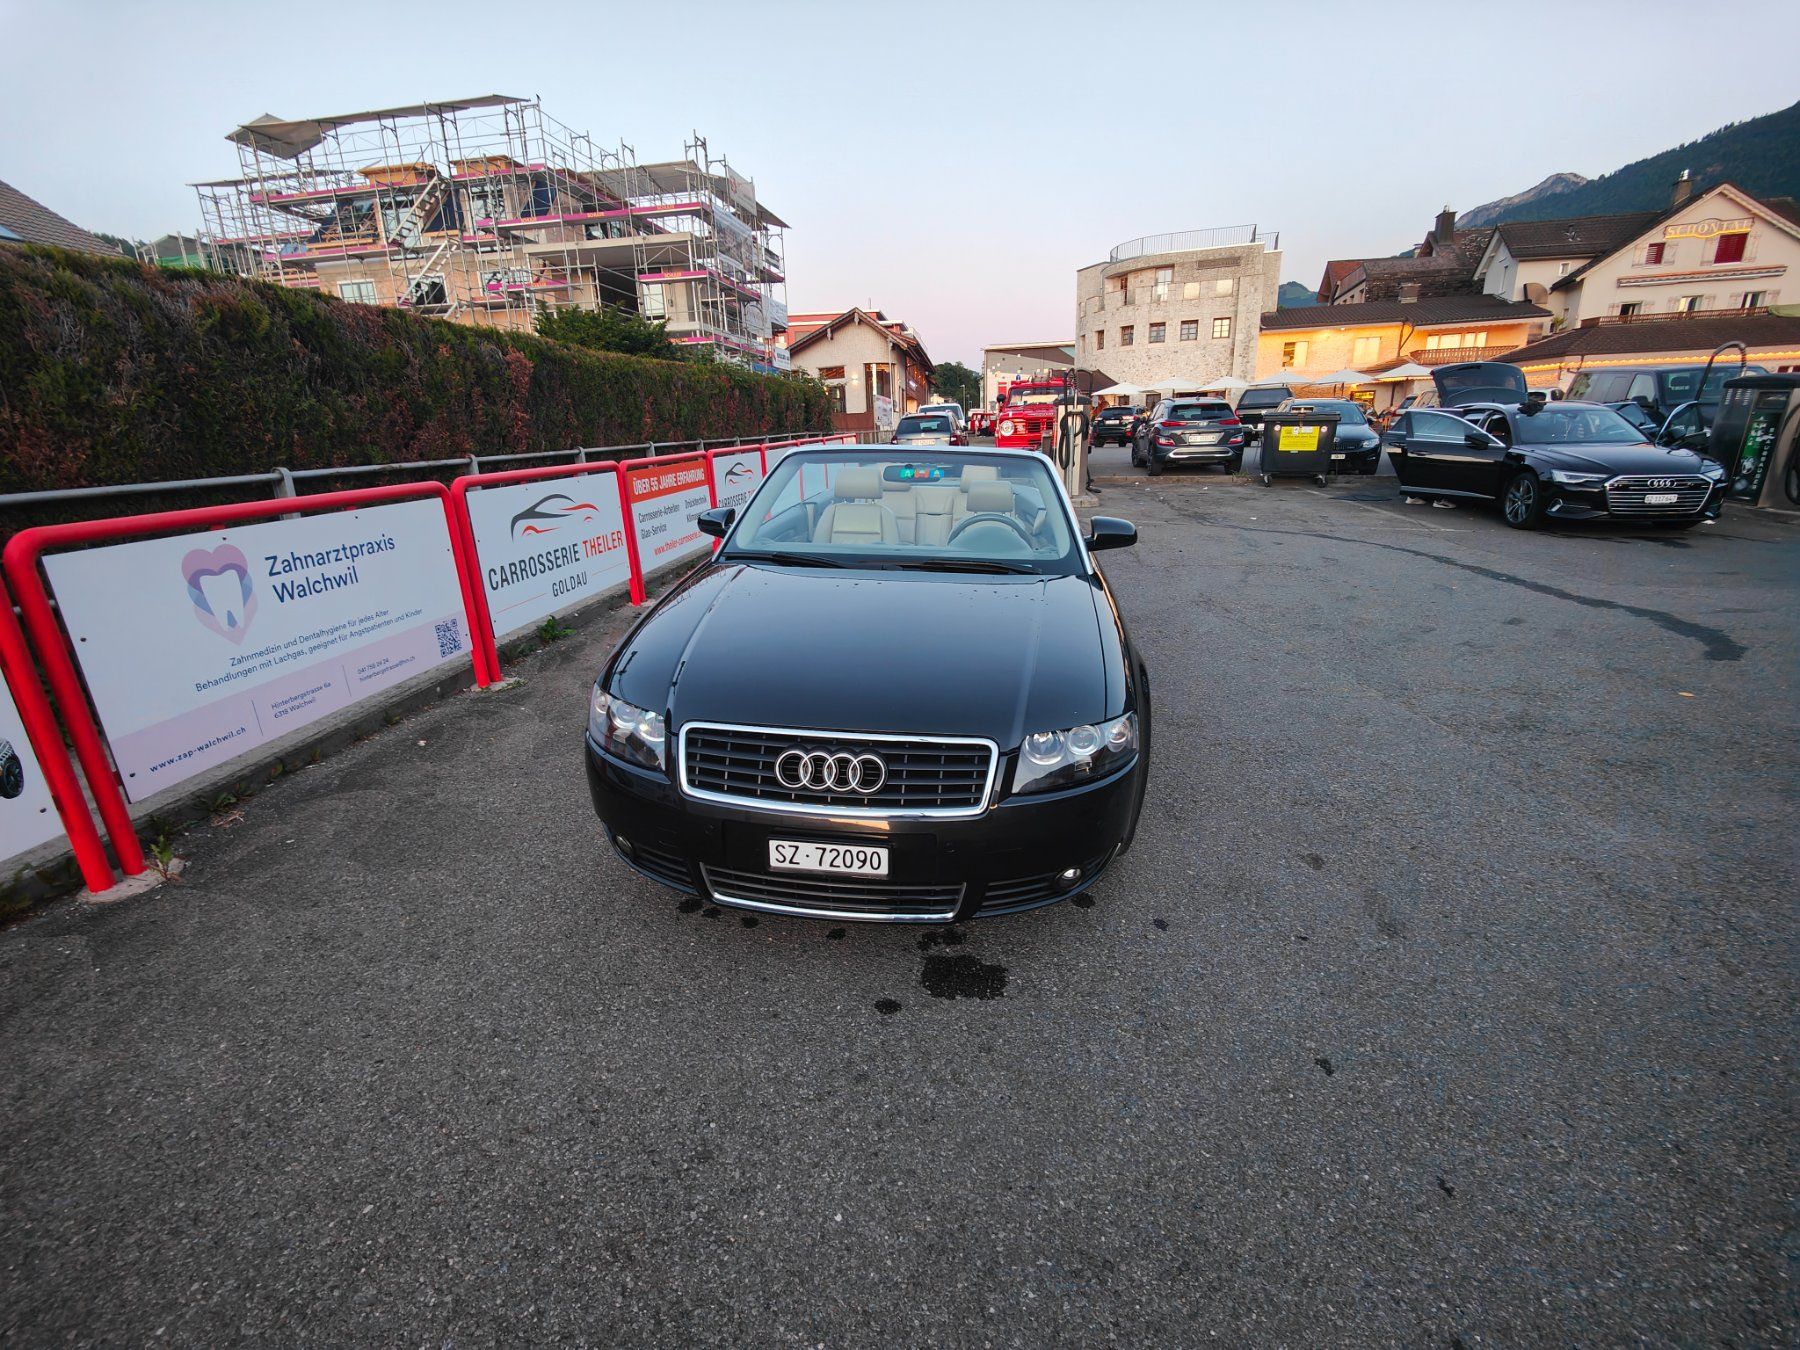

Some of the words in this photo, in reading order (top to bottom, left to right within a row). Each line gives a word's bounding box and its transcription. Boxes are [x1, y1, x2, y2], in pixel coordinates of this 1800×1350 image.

[632, 477, 651, 495] ÜBER
[659, 473, 677, 490] JAHRE
[676, 468, 705, 486] ERFAHRUNG
[640, 523, 667, 540] Glas-Service
[264, 533, 396, 577] Zahnarztpraxis
[488, 543, 580, 591] CARROSSERIE
[582, 530, 624, 558] THEILER
[272, 565, 359, 603] Walchwil
[552, 571, 588, 597] GOLDAU
[195, 664, 258, 692] Behandlungen
[259, 659, 273, 671] mit
[273, 648, 308, 666] Lachgas,
[308, 637, 338, 655] geeignet
[338, 633, 348, 643] für
[349, 619, 394, 639] Angstpatienten
[394, 614, 405, 623] und
[405, 608, 423, 618] Kinder
[230, 644, 282, 667] Zahnmedizin
[284, 638, 298, 649] und
[298, 623, 347, 644] Dentalhygiene
[347, 619, 357, 628] für
[357, 614, 375, 626] jedes
[375, 609, 389, 619] Alter
[271, 685, 323, 710] Hinterbergstrasse
[289, 696, 316, 713] Walchwil
[149, 726, 246, 773] www.zap-walchwil.ch
